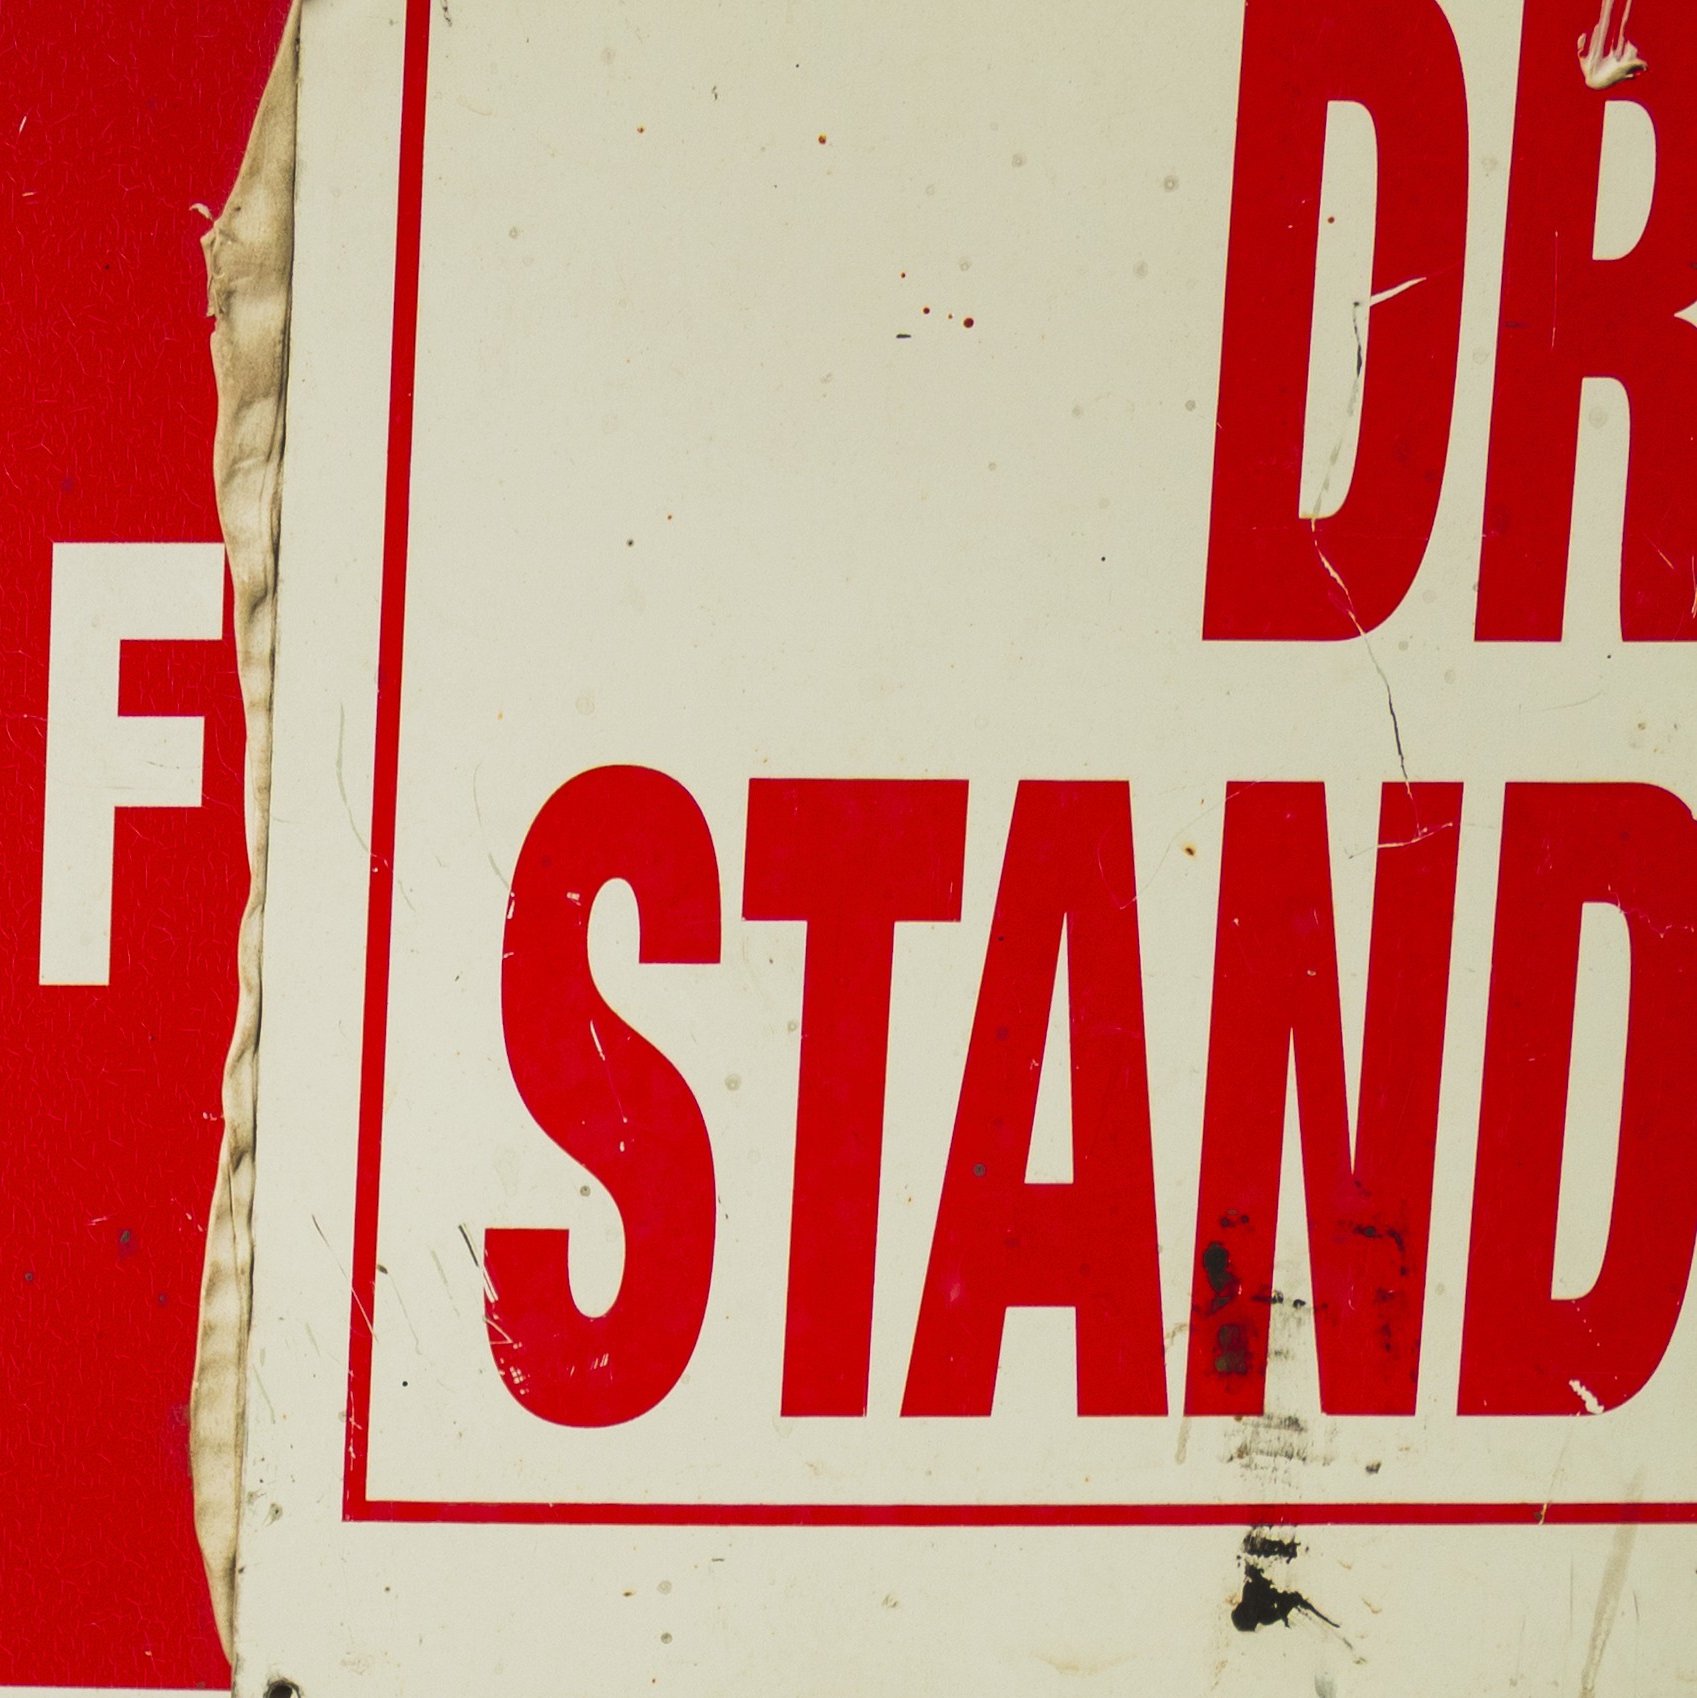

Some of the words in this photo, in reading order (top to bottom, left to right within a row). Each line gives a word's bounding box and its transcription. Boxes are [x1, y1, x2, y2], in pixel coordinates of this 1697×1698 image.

[1202, 0, 1697, 643] DR
[38, 541, 226, 986] F
[484, 763, 1697, 1430] STAND
